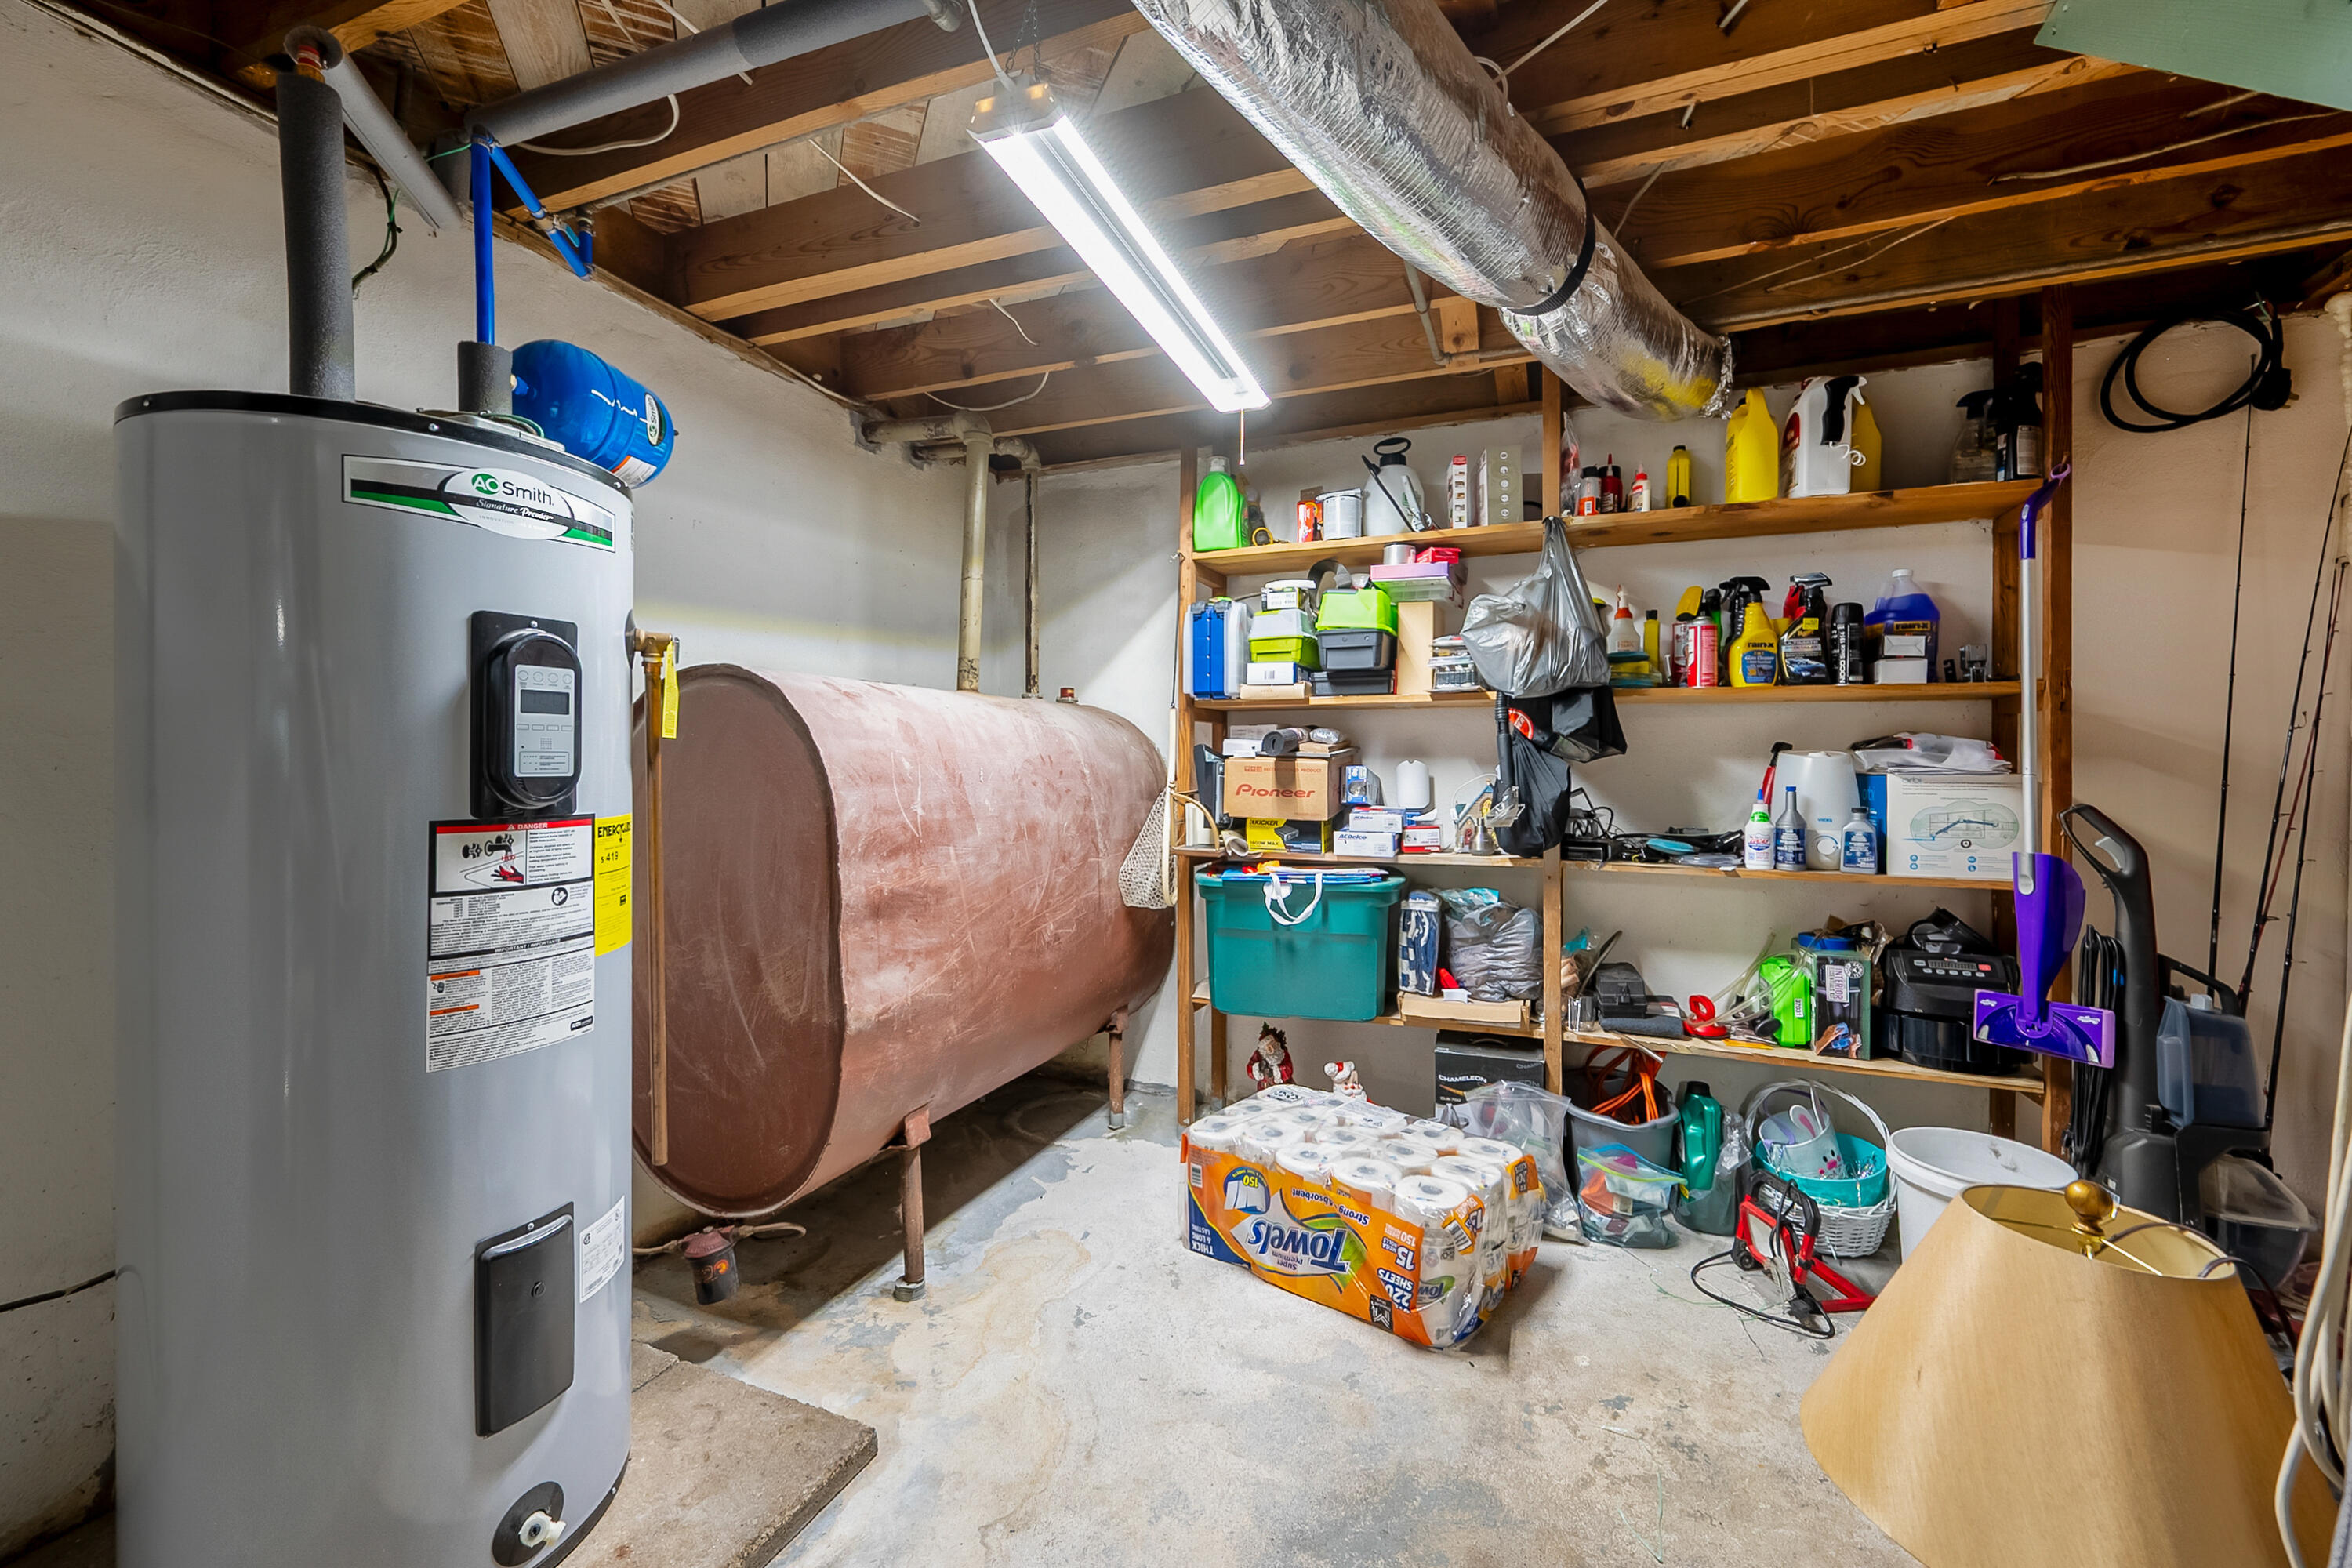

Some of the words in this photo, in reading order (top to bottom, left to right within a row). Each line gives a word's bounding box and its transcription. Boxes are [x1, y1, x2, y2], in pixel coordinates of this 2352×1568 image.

[502, 481, 552, 506] Smith
[476, 499, 518, 514] Signature
[1236, 783, 1316, 798] Pioneer
[495, 944, 527, 953] IMPORTANT
[1835, 968, 1844, 1000] INTERIOR
[1438, 1074, 1487, 1083] CHAMELEON
[1243, 1174, 1259, 1188] 150
[1292, 1188, 1334, 1207] Absorbent
[1338, 1204, 1370, 1225] Strong
[1247, 1218, 1350, 1274] Towels
[1400, 1232, 1416, 1246] 150
[1191, 1240, 1214, 1256] THICK
[1272, 1250, 1303, 1265] Premium
[1276, 1259, 1298, 1270] Super
[1396, 1246, 1415, 1270] 15
[1377, 1268, 1414, 1290] SHEETS
[1385, 1283, 1412, 1307] 220
